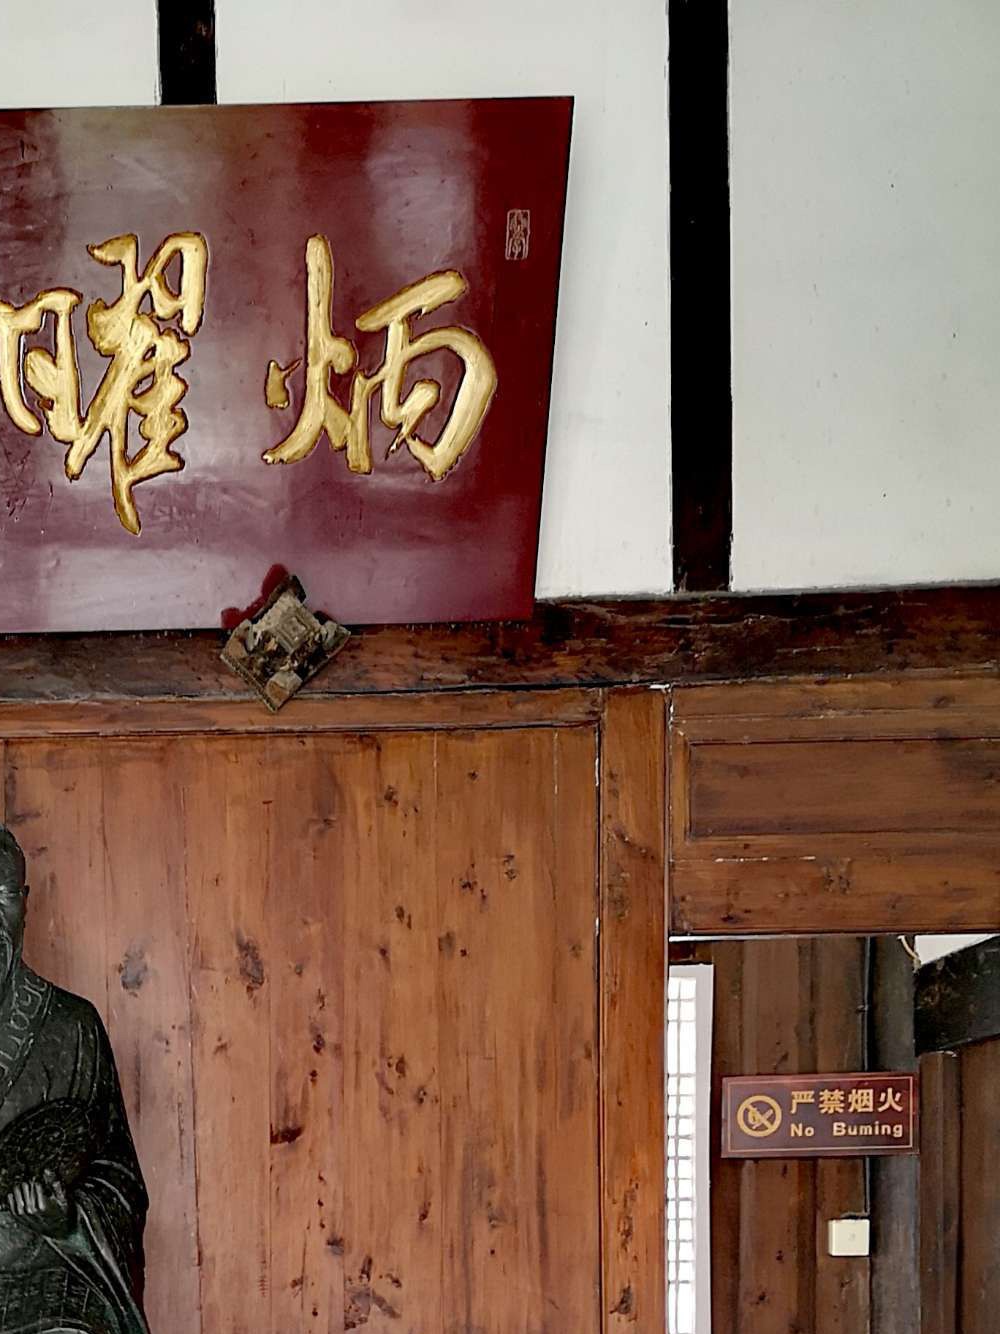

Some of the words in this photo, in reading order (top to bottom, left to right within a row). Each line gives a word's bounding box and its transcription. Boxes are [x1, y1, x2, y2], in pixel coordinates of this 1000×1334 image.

[790, 1087, 904, 1115] 严禁烟火
[790, 1123, 815, 1137] No
